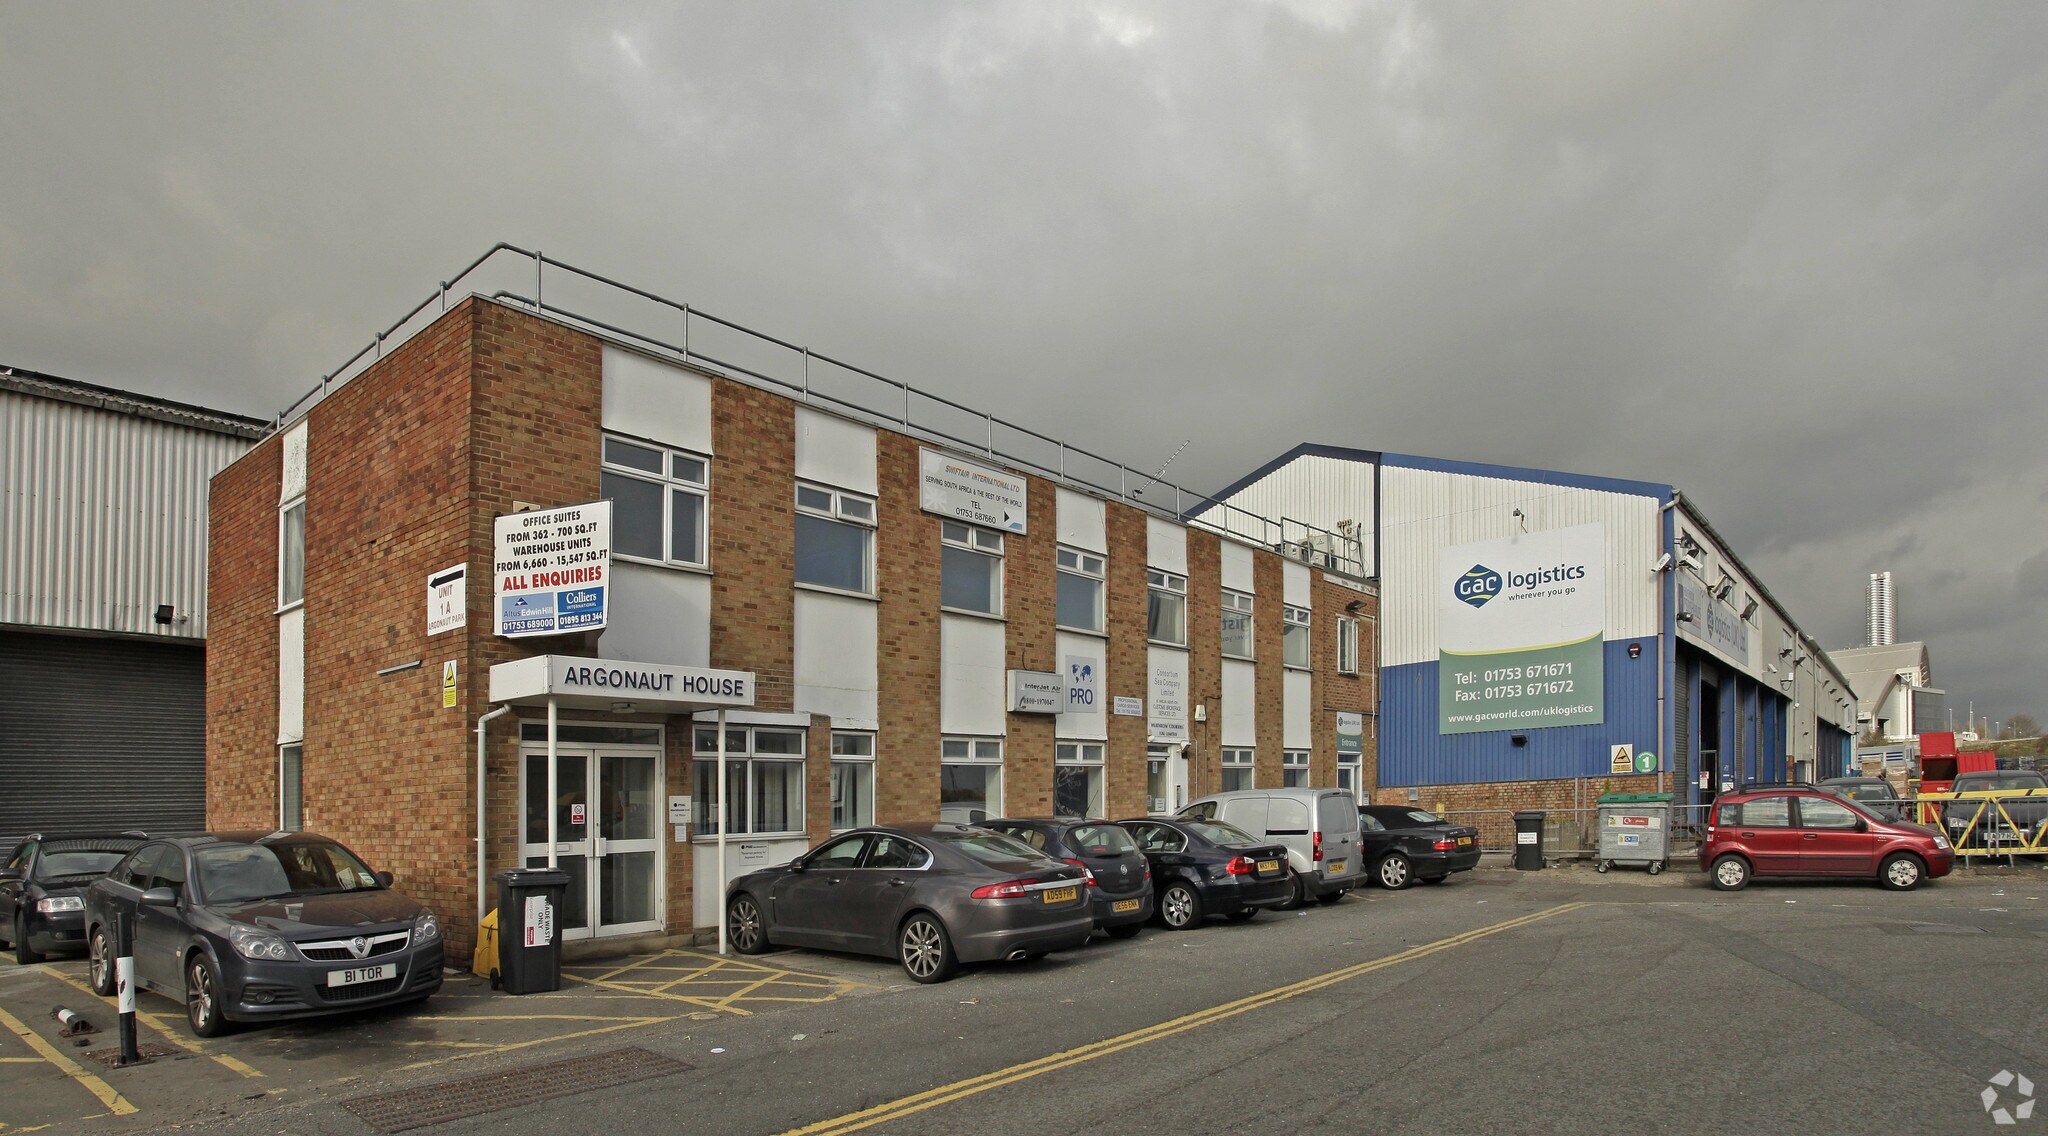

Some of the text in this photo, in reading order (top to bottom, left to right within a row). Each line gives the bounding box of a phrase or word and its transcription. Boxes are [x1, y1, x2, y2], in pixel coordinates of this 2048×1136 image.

[945, 465, 1020, 493] SWIFTAIR INTERNATIONAL LTD
[925, 475, 943, 487] SERVING
[944, 480, 958, 490] SOUTH
[958, 484, 973, 494] AFRICA
[977, 489, 985, 497] THE
[985, 491, 995, 500] REST
[996, 494, 1001, 502] OF
[1009, 499, 1022, 508] WORLD
[971, 500, 982, 510] TEL
[523, 510, 581, 527] OFFICE SUITES
[955, 507, 997, 524] 01753 687660
[506, 532, 530, 543] FROM
[532, 528, 549, 541] 362
[557, 526, 573, 538] 700
[575, 522, 598, 535] SQ.FT
[513, 537, 592, 556] WAREHOUSE UNITS
[496, 562, 521, 573] FROM
[523, 557, 548, 571] 6,660
[556, 552, 584, 567] 15,547
[585, 549, 608, 563] SQ.FT
[503, 565, 602, 591] ALL ENQUIRIES
[1507, 564, 1585, 590] logistics
[439, 584, 453, 598] UNIT
[566, 591, 597, 604] Colliers
[1508, 586, 1576, 601] wherever you go
[451, 613, 465, 623] PARK
[504, 610, 521, 618] Altus
[559, 615, 580, 625] 01895
[580, 613, 591, 622] 813
[592, 612, 603, 621] 344
[503, 620, 526, 631] 01753
[527, 618, 554, 629] 689000
[564, 666, 744, 696] ARGONAUT HOUSE
[1157, 668, 1178, 678] Consortium
[1455, 662, 1573, 685] Tel: 01753 671671
[1154, 677, 1180, 690] Sea Company
[1455, 680, 1574, 702] Fax: 01753 671672
[1070, 688, 1093, 705] PRO
[1161, 688, 1175, 697] Limited
[1448, 704, 1593, 723] www.gacworld.com/uklogistics
[1643, 756, 1650, 768] 1
[360, 967, 382, 980] TOR
